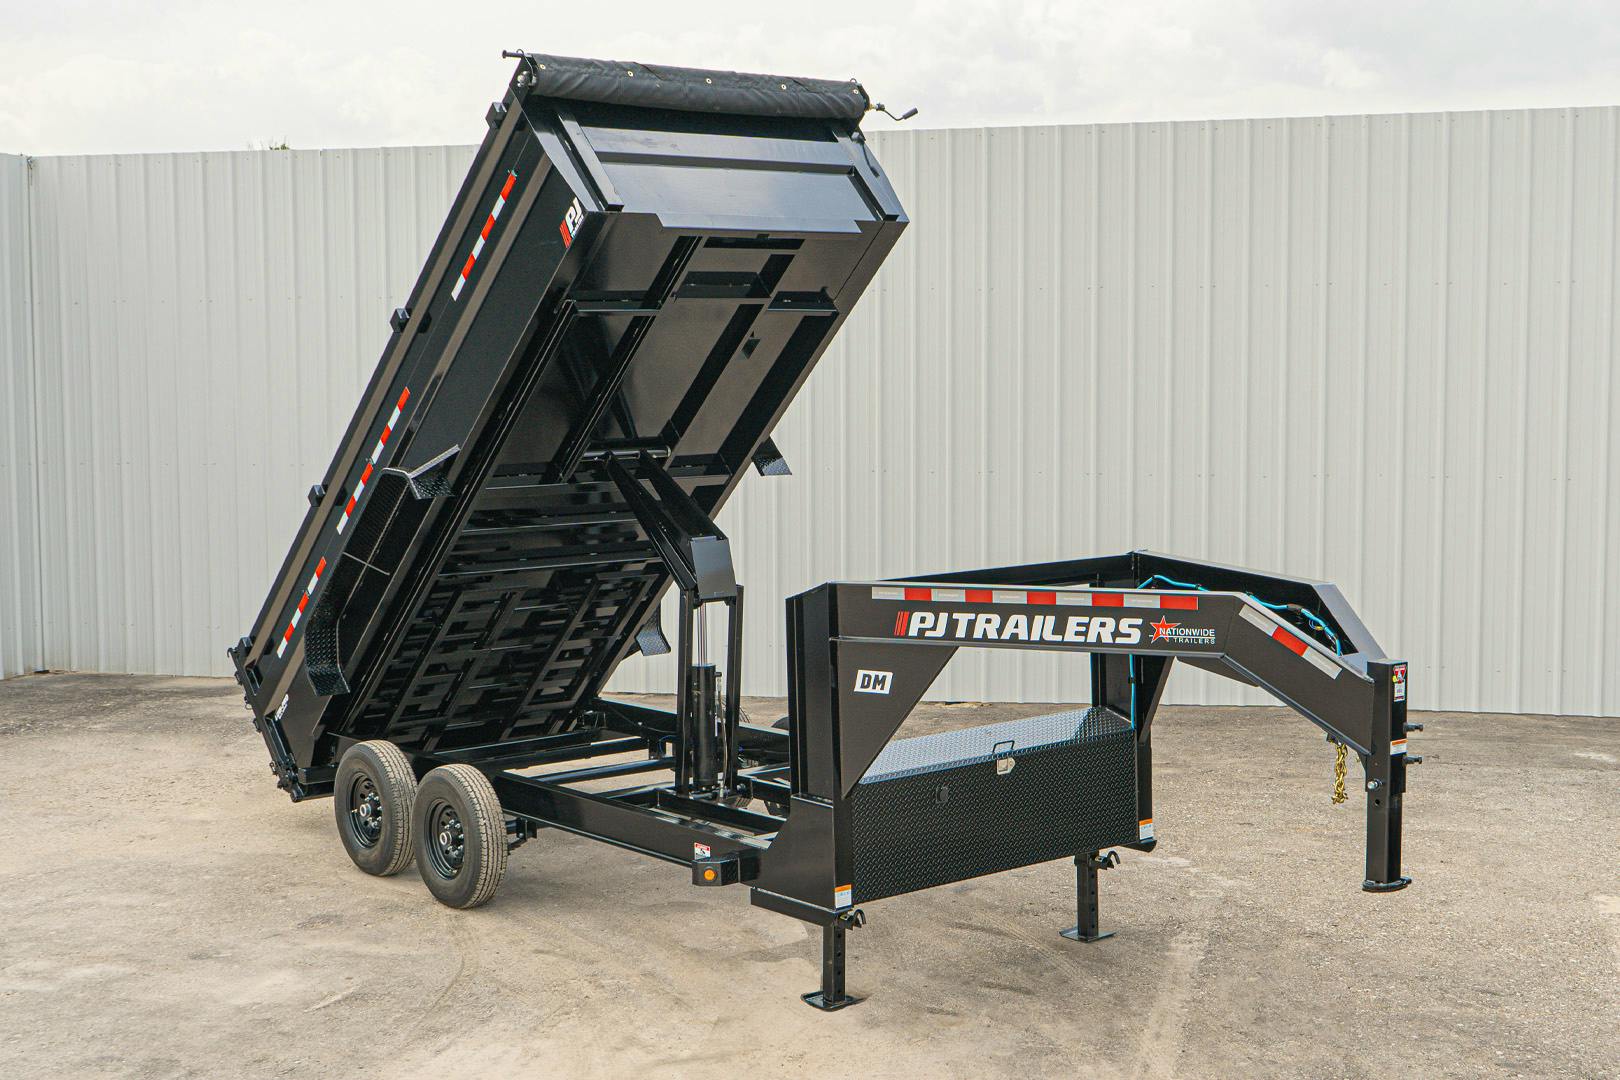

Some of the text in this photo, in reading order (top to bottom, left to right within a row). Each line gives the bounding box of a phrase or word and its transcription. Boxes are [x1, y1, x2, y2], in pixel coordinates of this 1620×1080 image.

[908, 611, 1143, 645] PJ TRAILERS
[1159, 627, 1215, 636] NATIONWIDE
[1173, 637, 1216, 645] TRAILERS
[860, 673, 887, 690] DM
